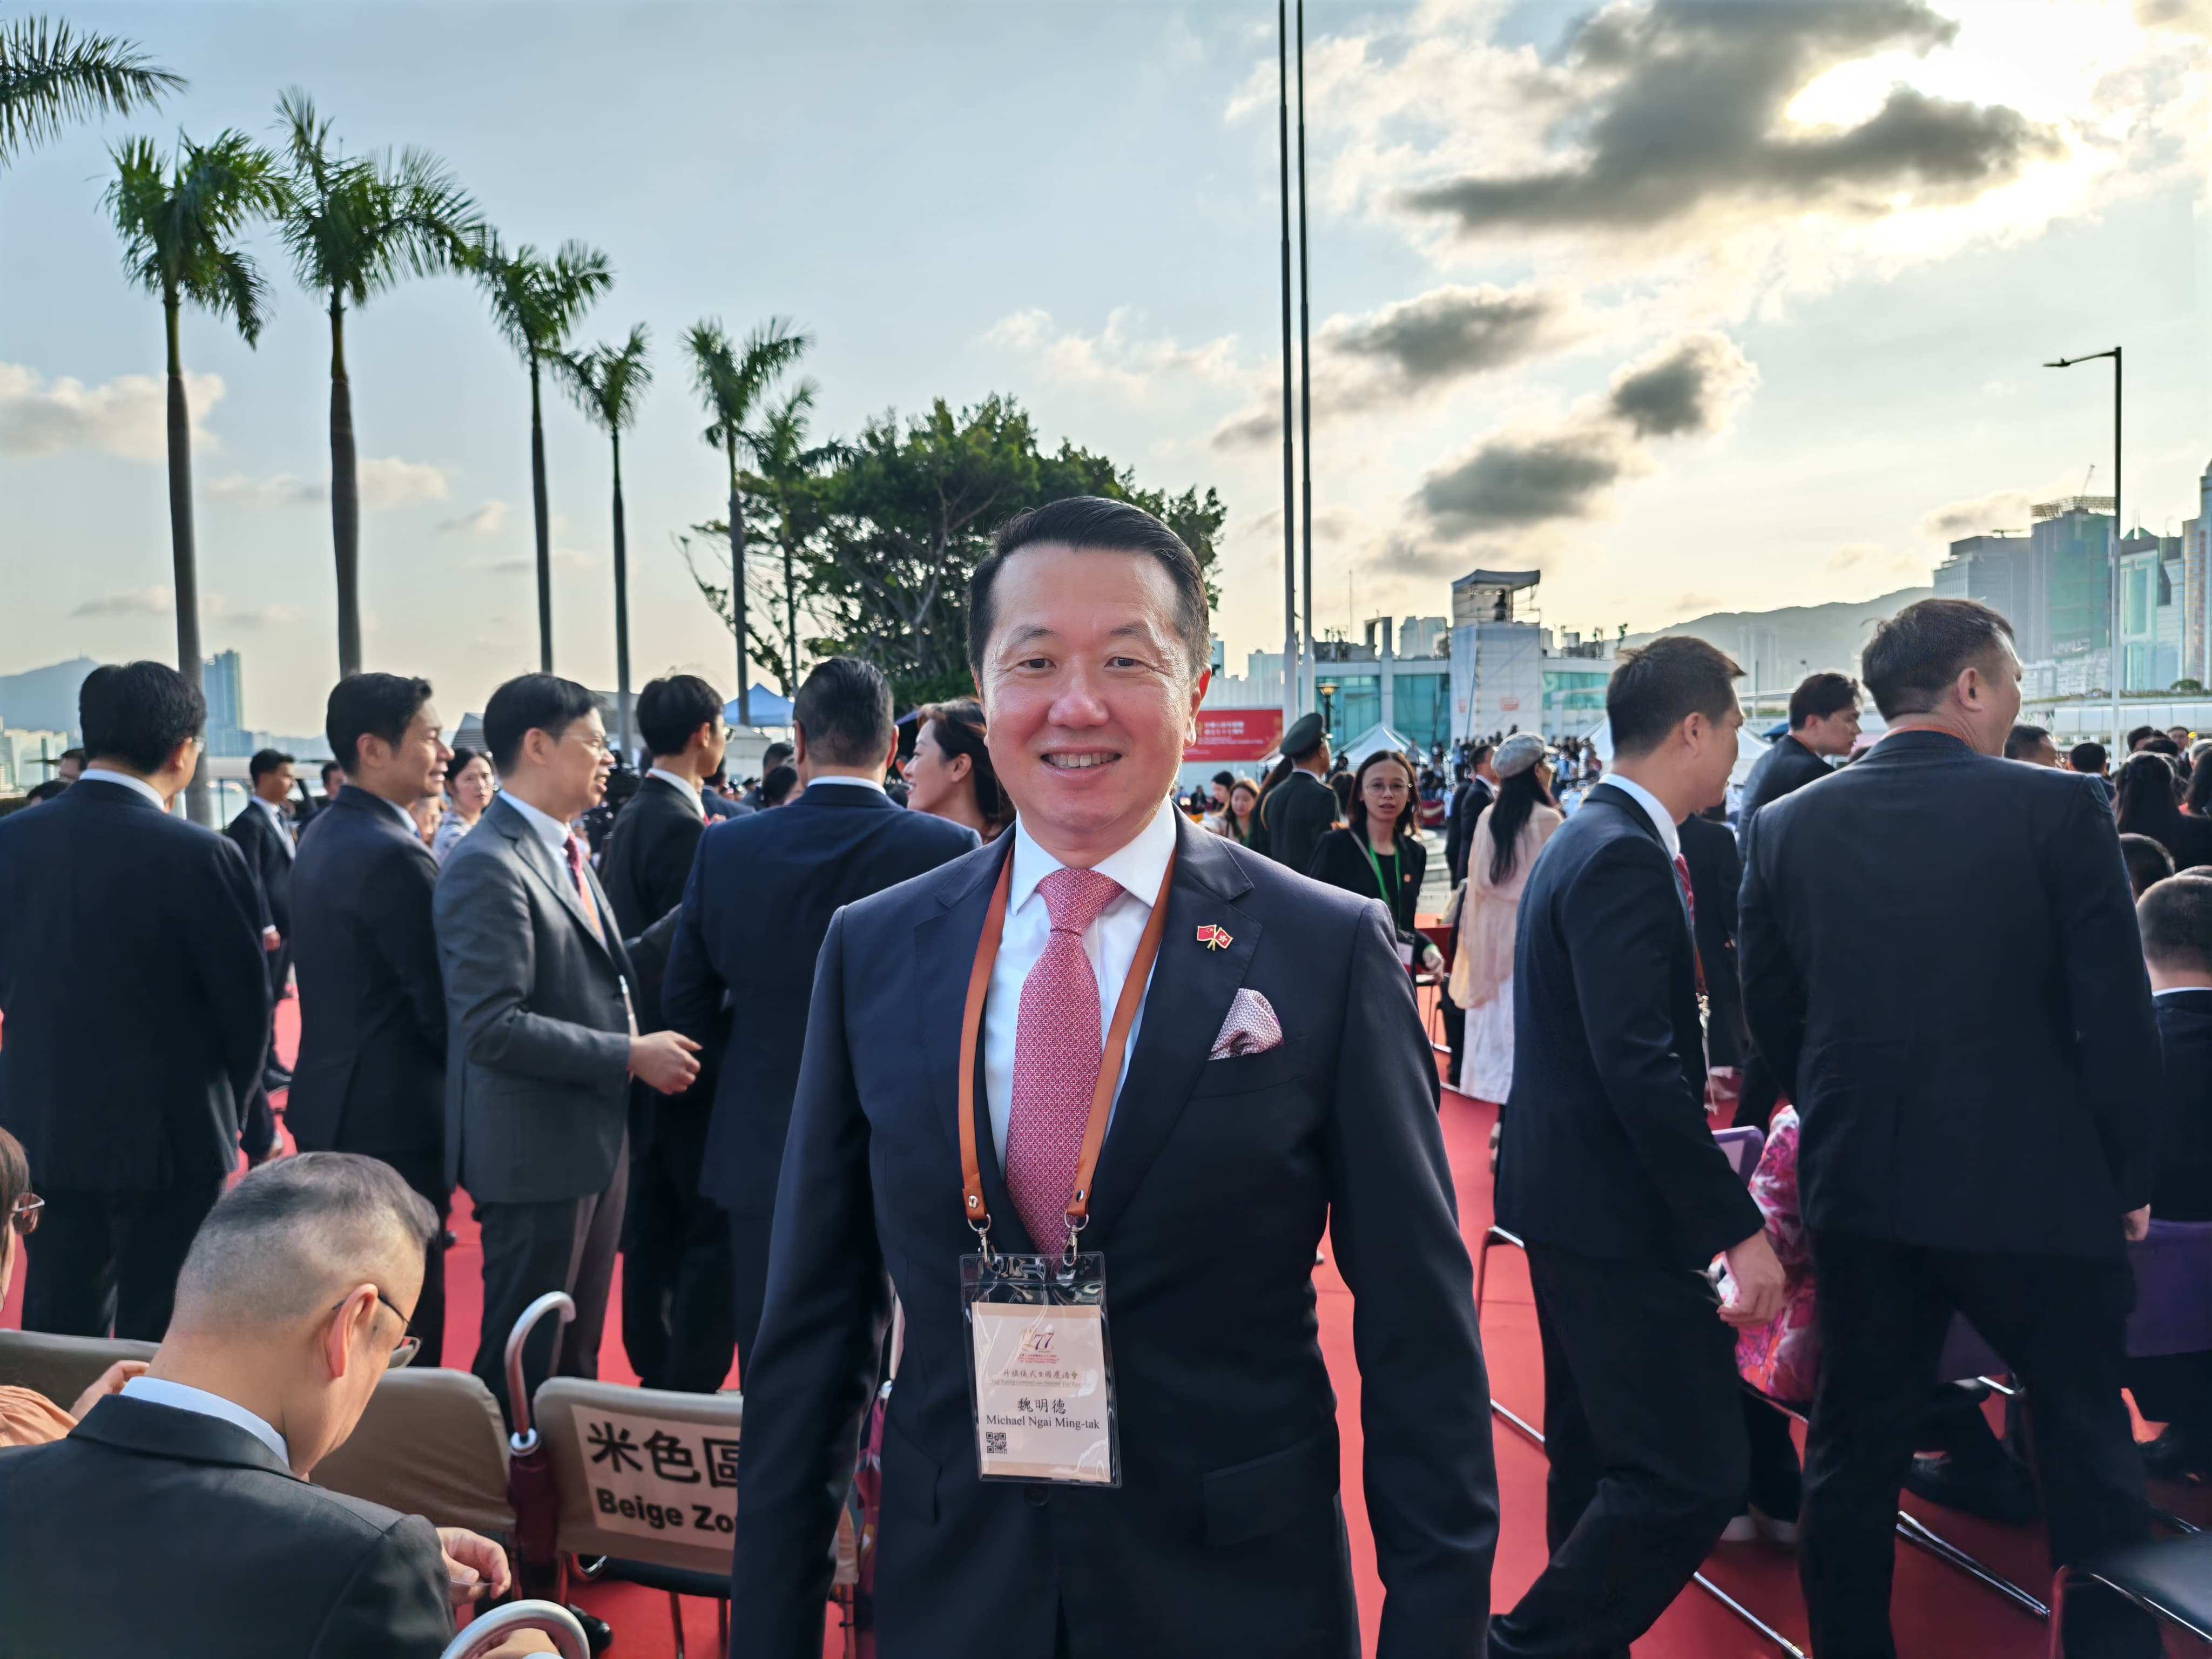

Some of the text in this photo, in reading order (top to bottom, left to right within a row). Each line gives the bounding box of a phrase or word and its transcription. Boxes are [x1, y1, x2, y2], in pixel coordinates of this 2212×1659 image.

[1017, 1397, 1067, 1414] 魏明德
[986, 1414, 1101, 1431] Michael Ngai Ming-tak
[586, 1421, 740, 1489] 米色區
[597, 1488, 736, 1533] Beige Zo
